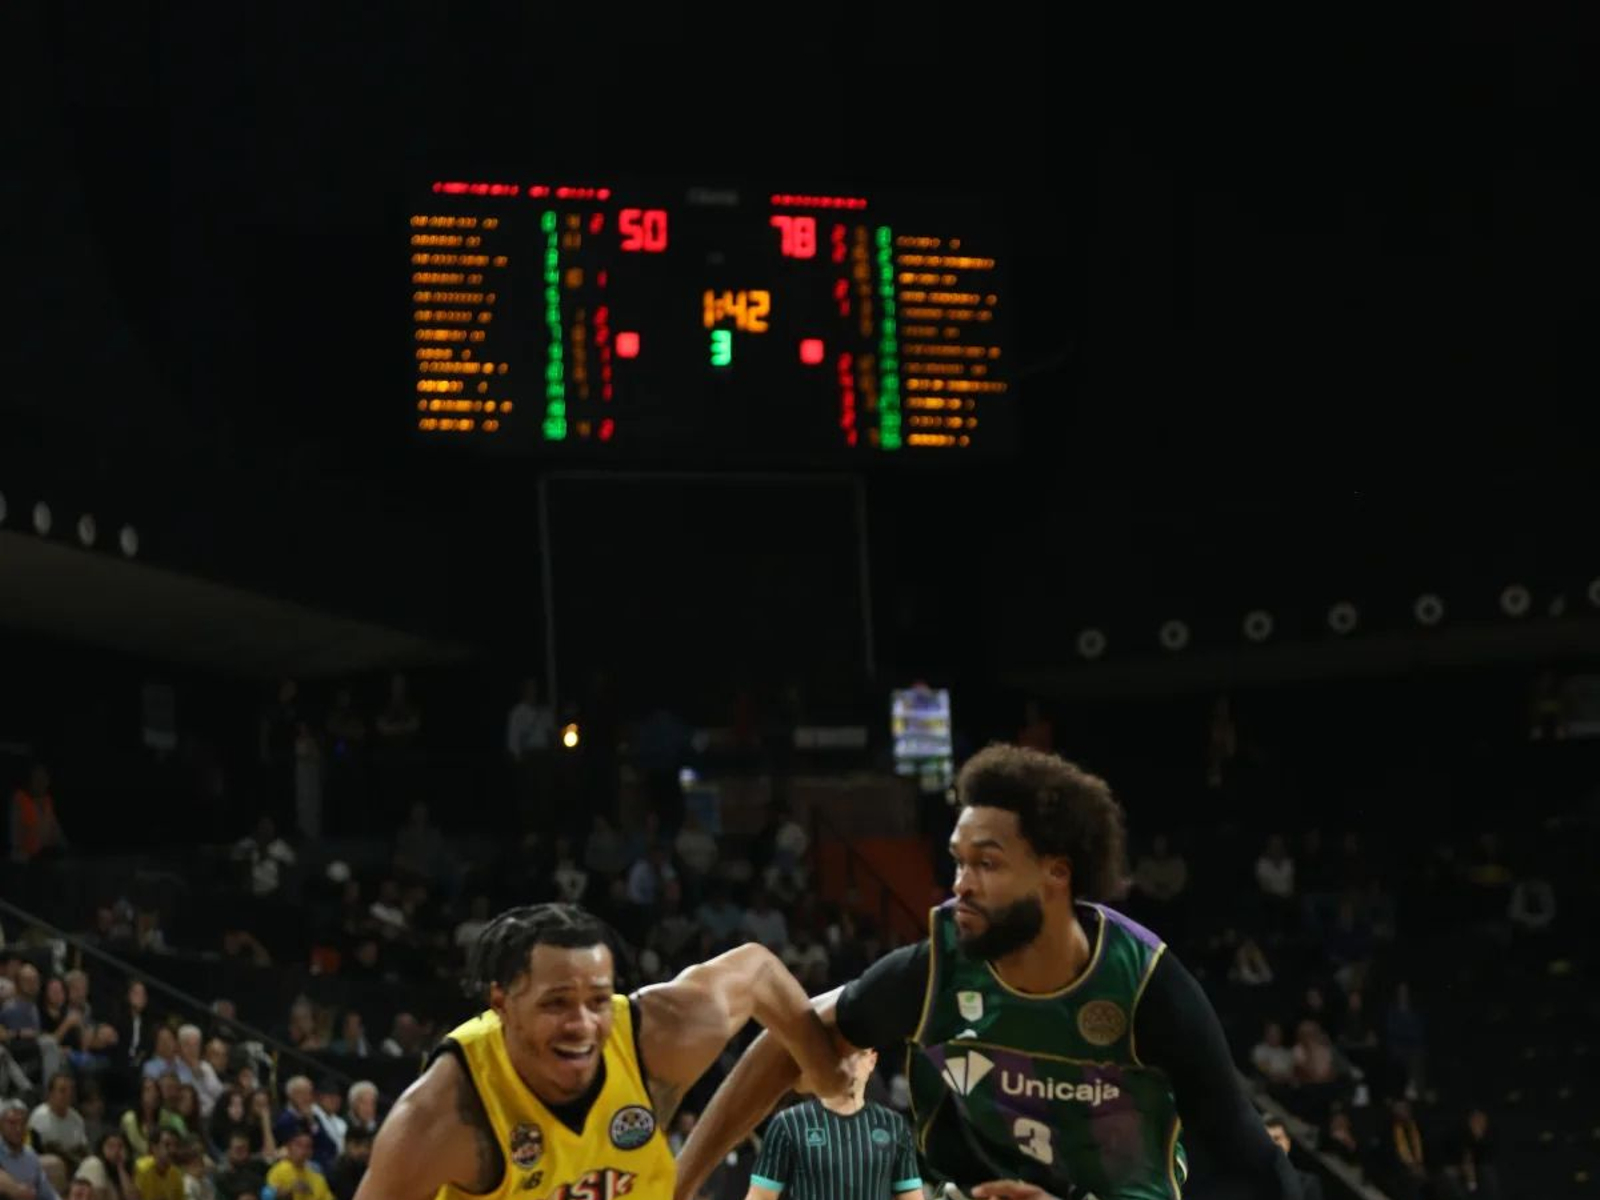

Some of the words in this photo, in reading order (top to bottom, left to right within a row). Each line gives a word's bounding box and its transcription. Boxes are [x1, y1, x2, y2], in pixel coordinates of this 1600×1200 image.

[618, 207, 668, 253] 50
[769, 214, 818, 260] 78
[702, 288, 771, 333] 1:42
[709, 329, 733, 367] 3
[1000, 1069, 1121, 1107] Unicaja
[1012, 1116, 1054, 1166] 3
